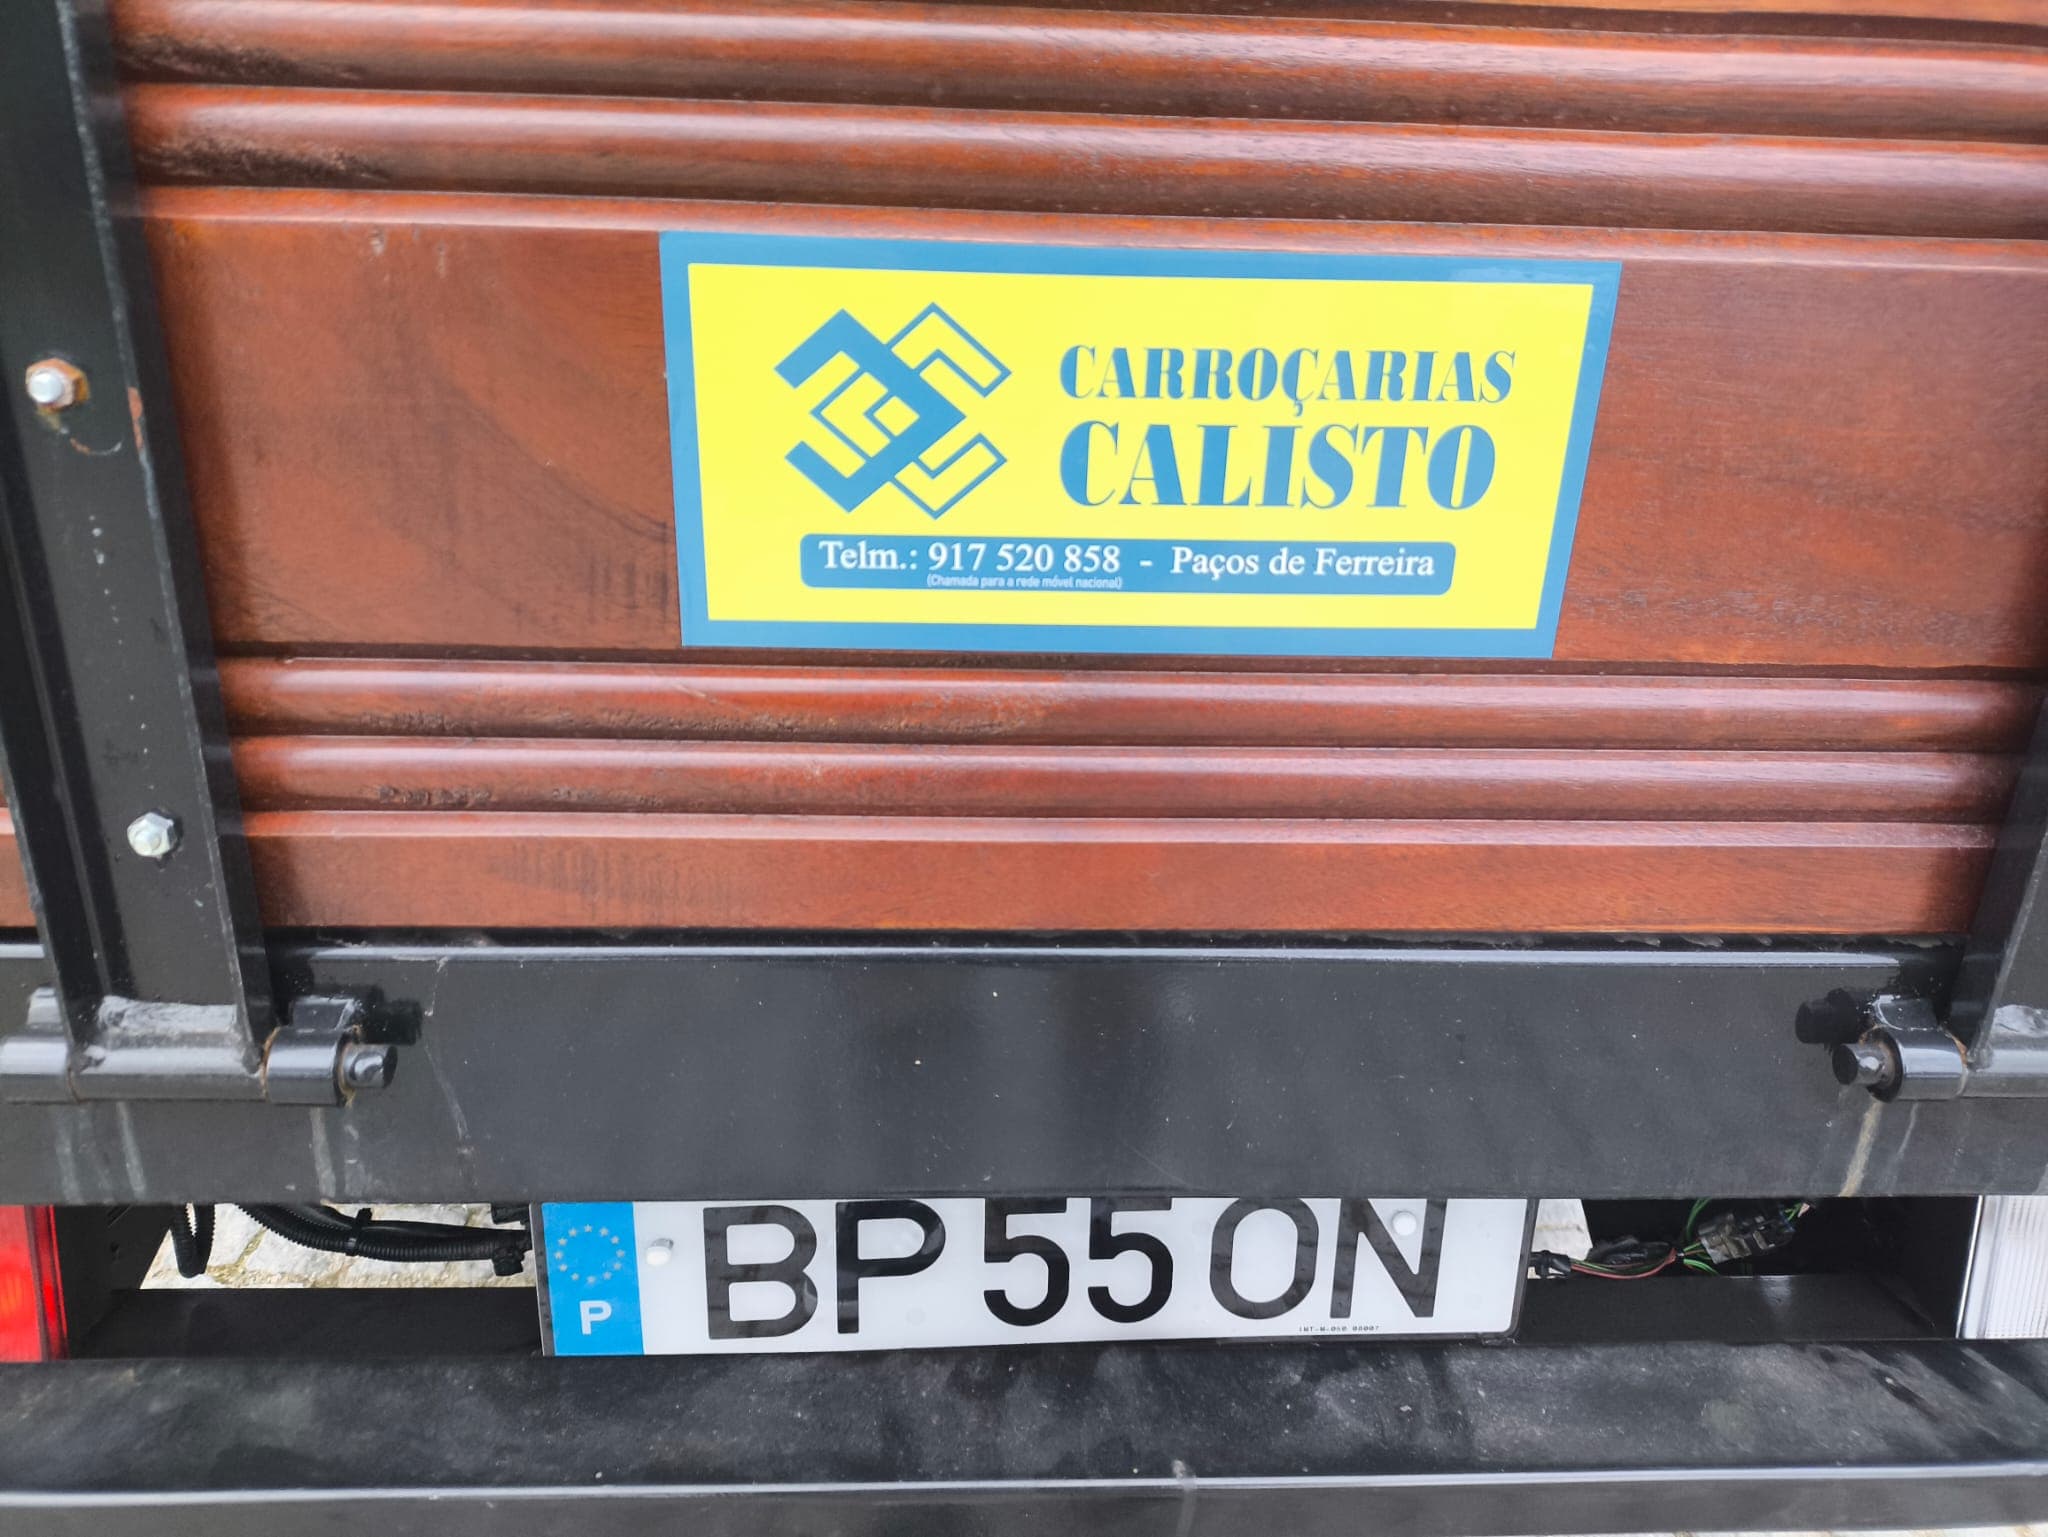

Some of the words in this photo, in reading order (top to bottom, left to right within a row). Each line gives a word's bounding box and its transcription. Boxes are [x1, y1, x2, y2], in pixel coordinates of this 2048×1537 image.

[1059, 345, 1516, 416] CARROÇARIAS
[1059, 420, 1496, 510] CALISTO
[818, 540, 918, 570] Telm.:
[927, 542, 987, 571] 917
[996, 543, 1054, 572] 520
[1063, 545, 1121, 573] 858
[1170, 546, 1260, 580] Paços
[1268, 547, 1305, 575] de
[1313, 547, 1435, 576] Ferreira
[981, 576, 1005, 589] para
[1015, 576, 1040, 588] rede
[1042, 575, 1073, 588] móvel
[703, 1200, 946, 1340] BP
[984, 1198, 1174, 1327] 55
[1210, 1198, 1448, 1320] ON
[579, 1300, 612, 1335] P
